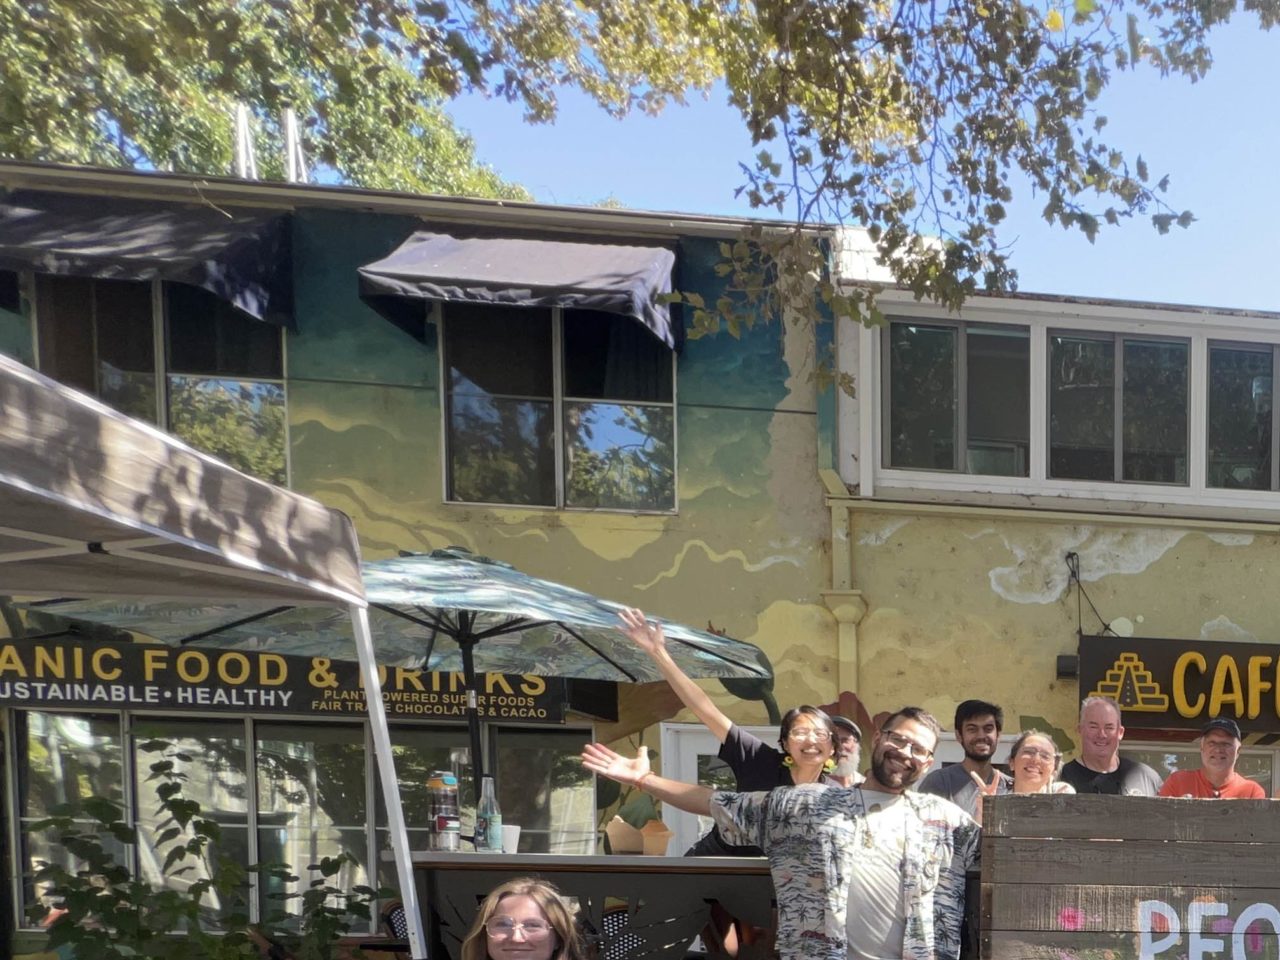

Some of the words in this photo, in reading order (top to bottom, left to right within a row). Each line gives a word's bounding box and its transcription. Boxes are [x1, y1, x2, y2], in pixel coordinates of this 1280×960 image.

[143, 650, 288, 685] FOOD
[308, 656, 339, 688] &
[442, 694, 487, 705] SUPR
[490, 696, 535, 706] FOODS
[311, 701, 342, 711] FAIR
[346, 702, 391, 713] TRE
[395, 703, 485, 716] CHOCOLATS
[488, 707, 497, 716] &
[500, 707, 547, 718] CACAO
